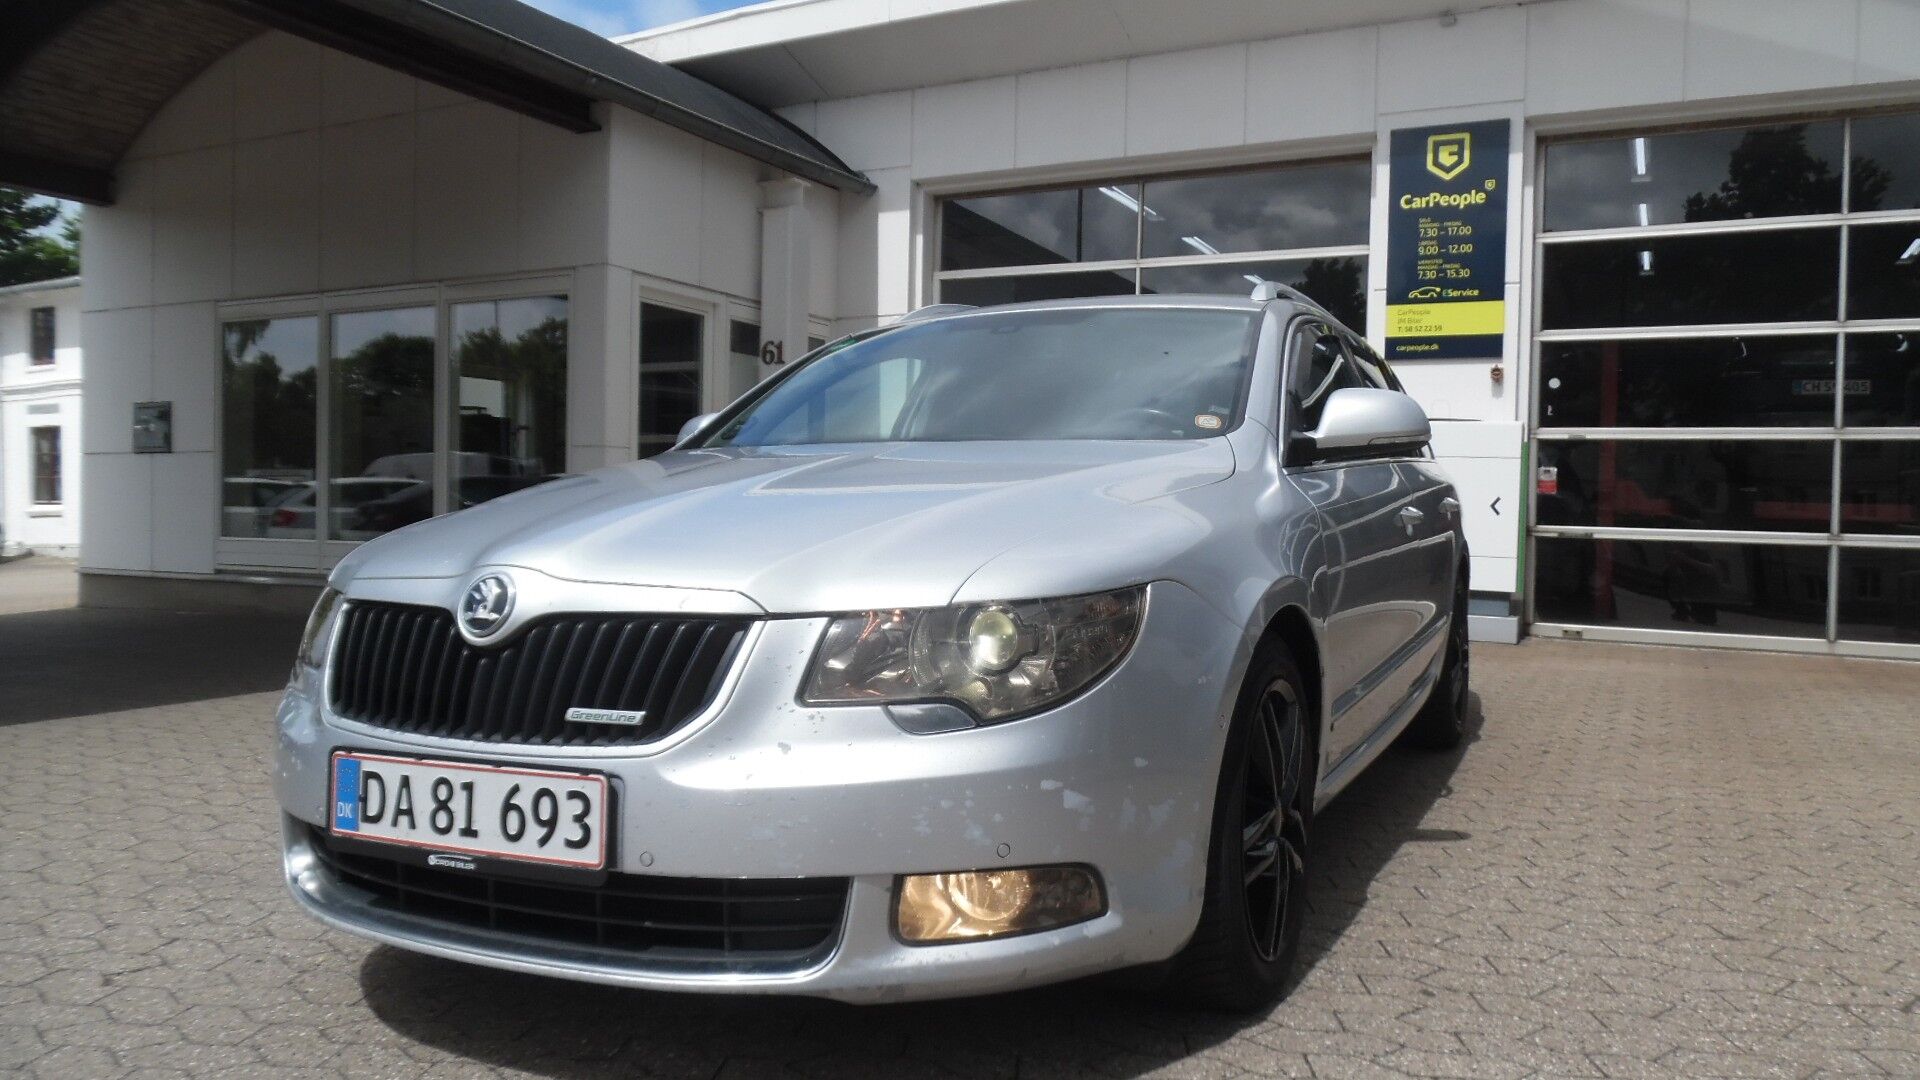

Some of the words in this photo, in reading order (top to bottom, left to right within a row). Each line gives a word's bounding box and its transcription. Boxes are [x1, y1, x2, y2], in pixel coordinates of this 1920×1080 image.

[1400, 190, 1487, 209] CarPeople
[1419, 228, 1438, 238] 7.30
[1448, 225, 1472, 236] 17.00
[1418, 245, 1439, 255] 9.00
[1448, 243, 1473, 254] 12.00
[1417, 270, 1437, 280] 7.30
[1446, 268, 1471, 278] 15.30
[761, 340, 786, 366] 61
[336, 801, 352, 819] DK
[360, 769, 416, 830] DA
[429, 776, 478, 838] 81
[500, 783, 592, 849] 693
